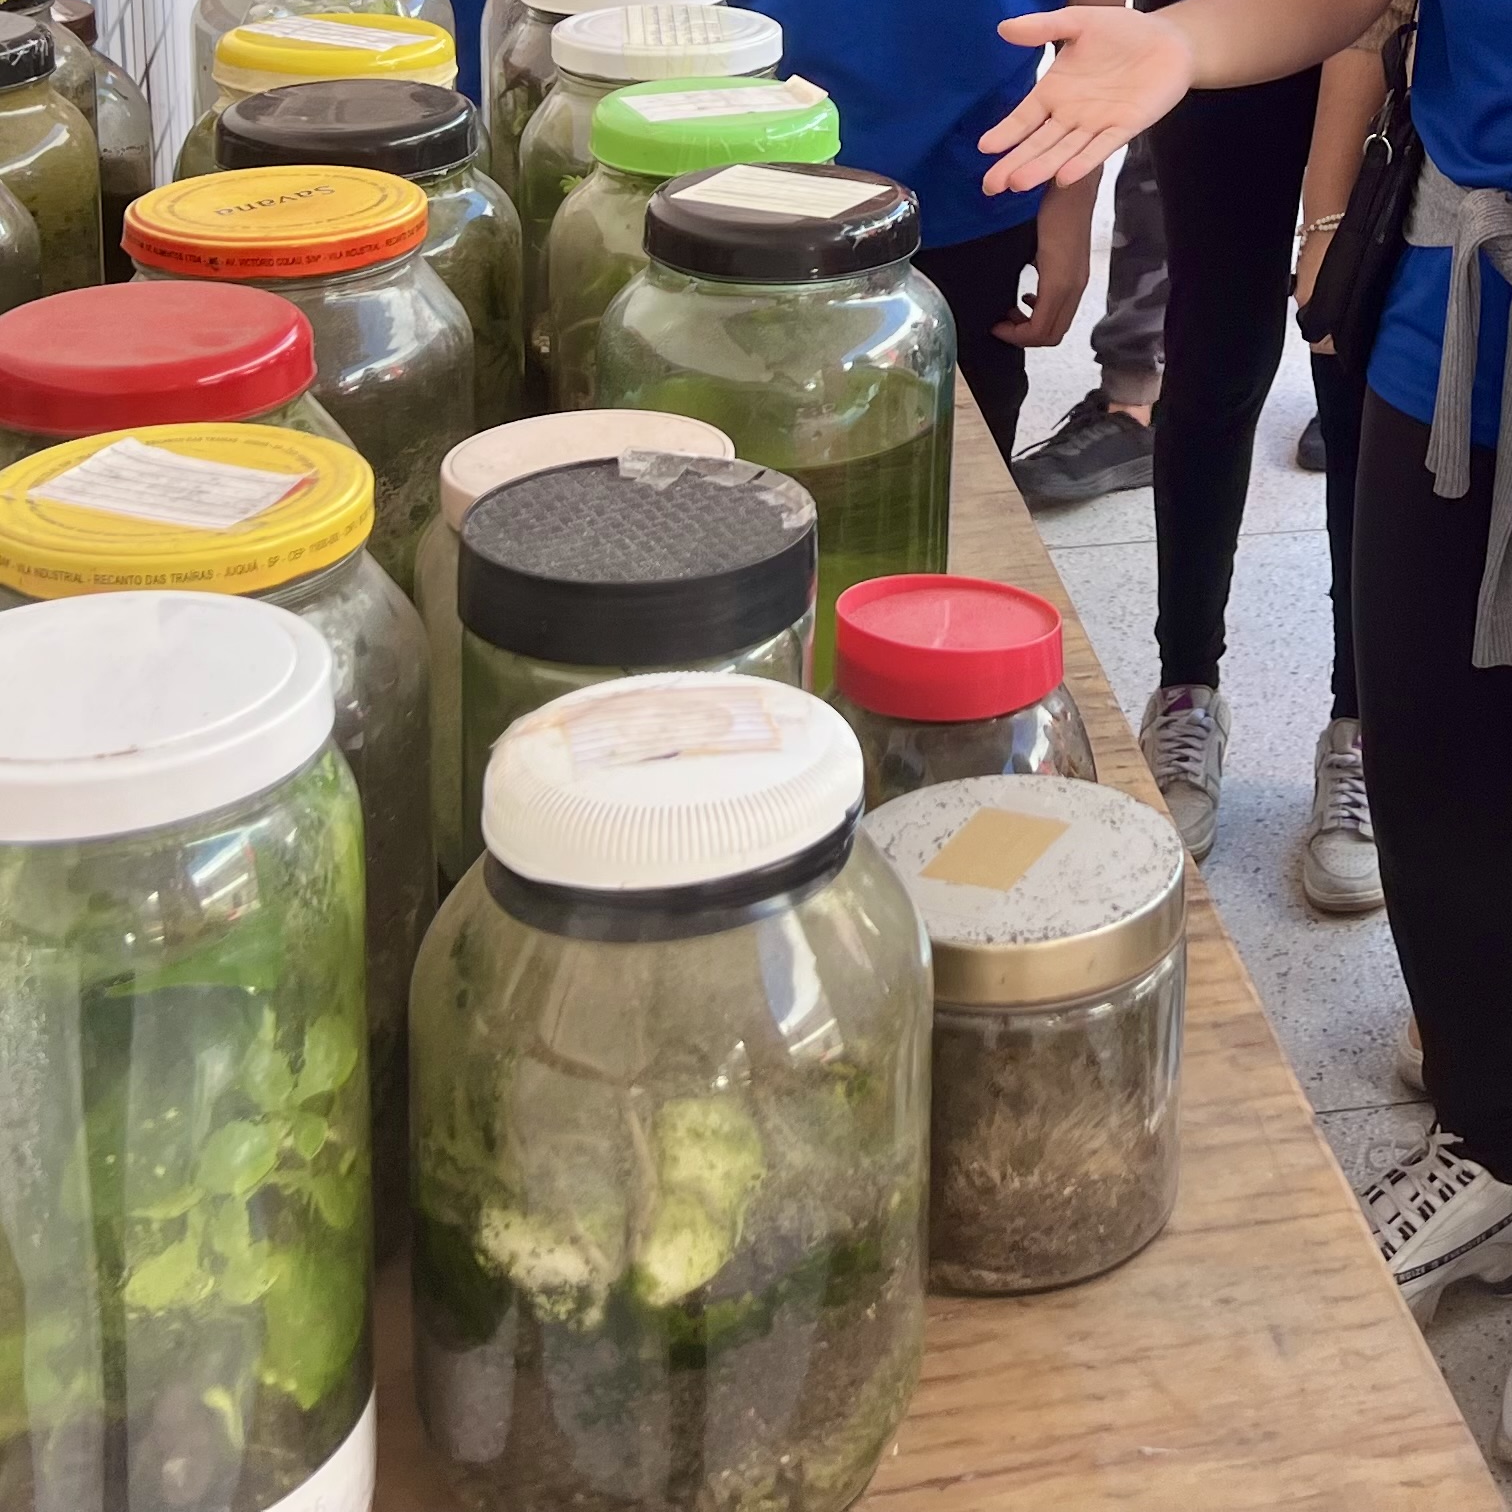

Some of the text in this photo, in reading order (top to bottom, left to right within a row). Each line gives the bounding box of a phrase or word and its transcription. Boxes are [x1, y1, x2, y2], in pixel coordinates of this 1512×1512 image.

[214, 185, 335, 216] Savana
[94, 574, 142, 586] RECANTO
[145, 573, 167, 586] DAS
